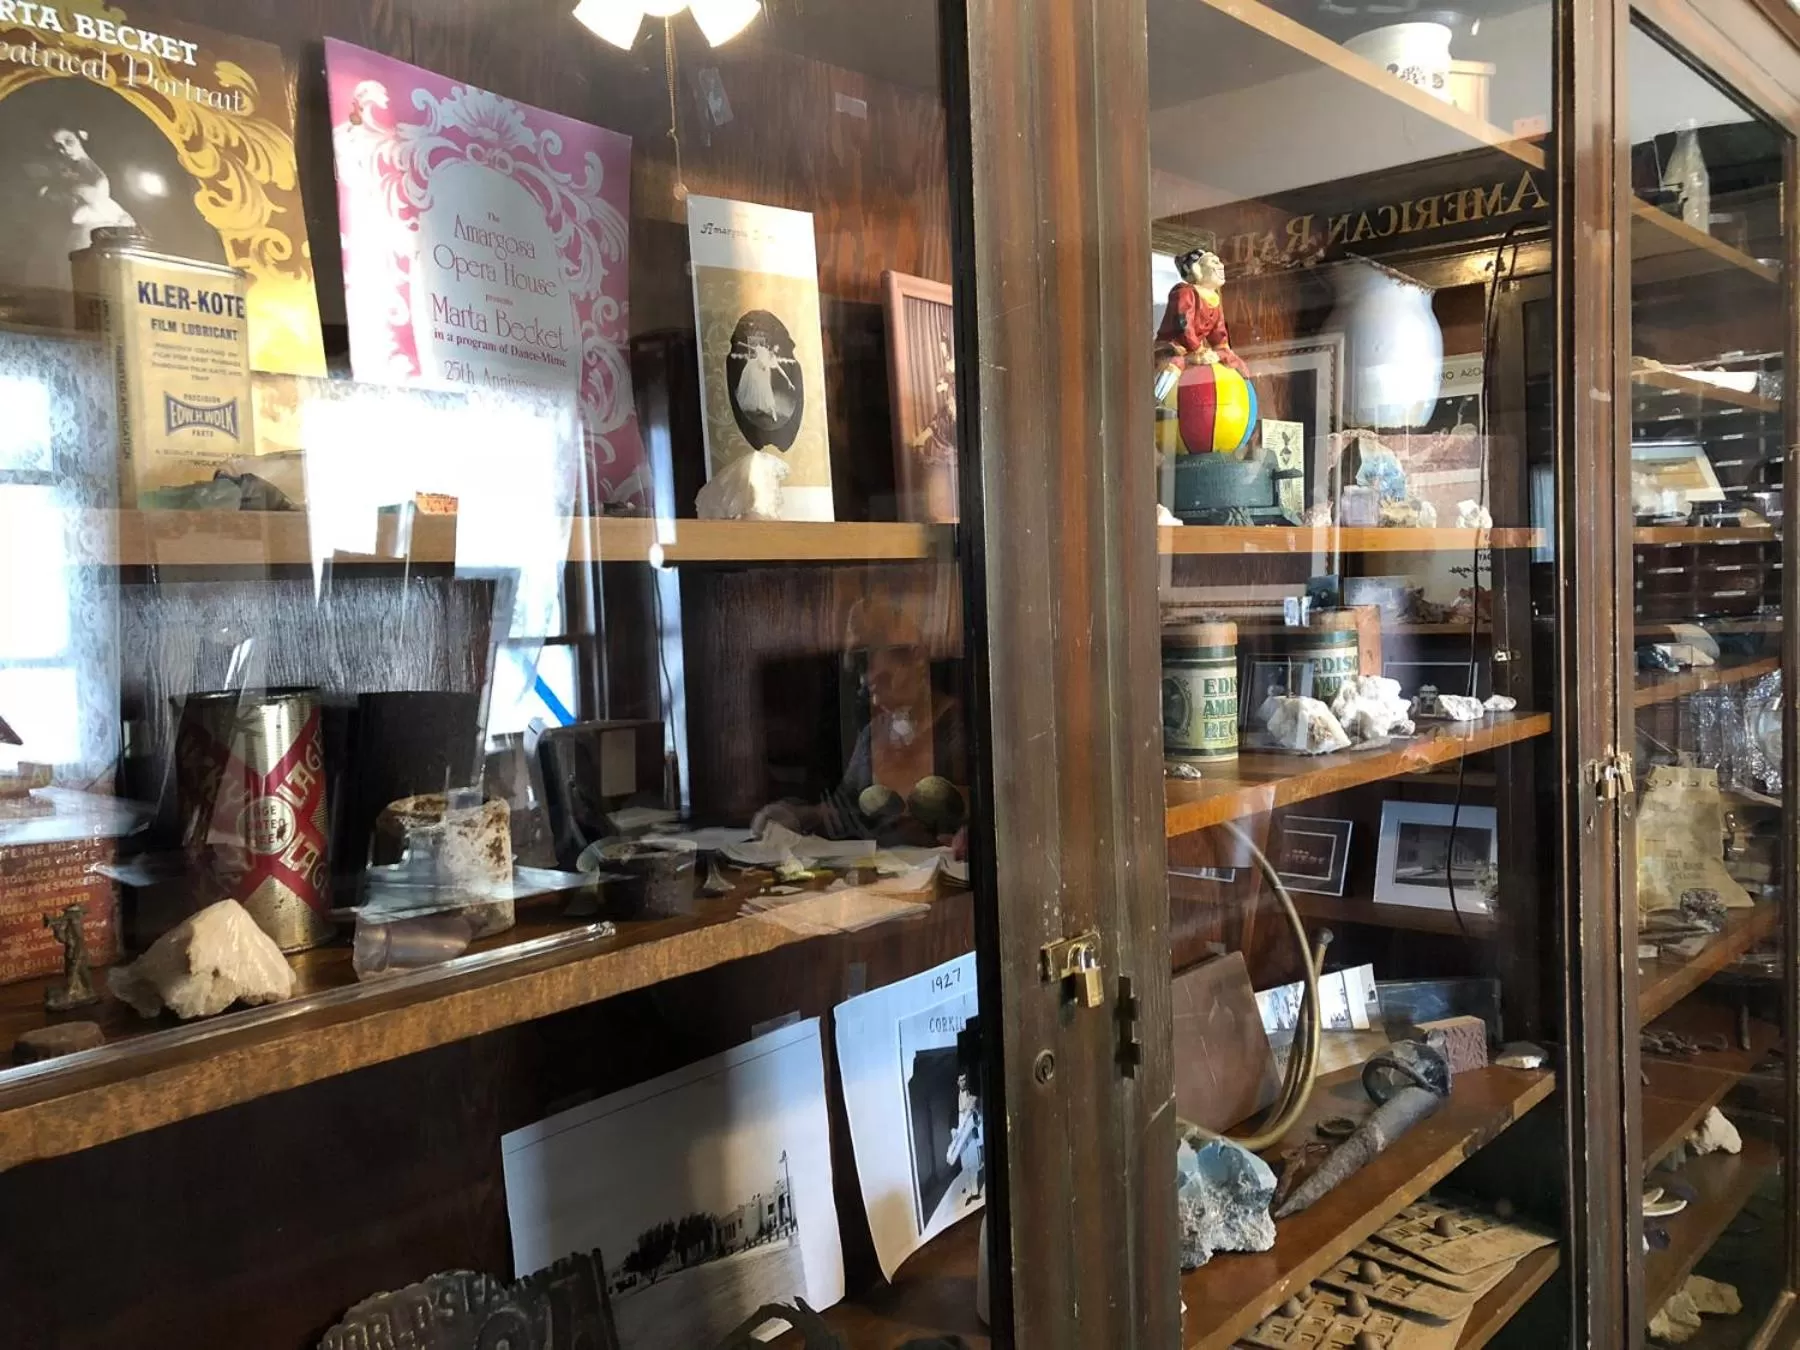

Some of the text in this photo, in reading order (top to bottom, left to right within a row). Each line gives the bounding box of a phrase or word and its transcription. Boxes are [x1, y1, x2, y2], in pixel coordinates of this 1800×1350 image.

[73, 13, 198, 66] BECKET
[121, 54, 243, 113] Portrait
[454, 214, 536, 260] Amargosa
[433, 244, 557, 298] Opera House
[137, 281, 245, 319] KLER-KOTE
[151, 318, 239, 341] FILM LUBRICANT
[431, 293, 568, 352] Marta Becket
[433, 328, 444, 339] in
[447, 333, 454, 342] a
[456, 335, 497, 353] program
[498, 343, 509, 353] of
[444, 360, 476, 386] 25th
[38, 892, 90, 907] PATENTED
[932, 967, 961, 992] 1927
